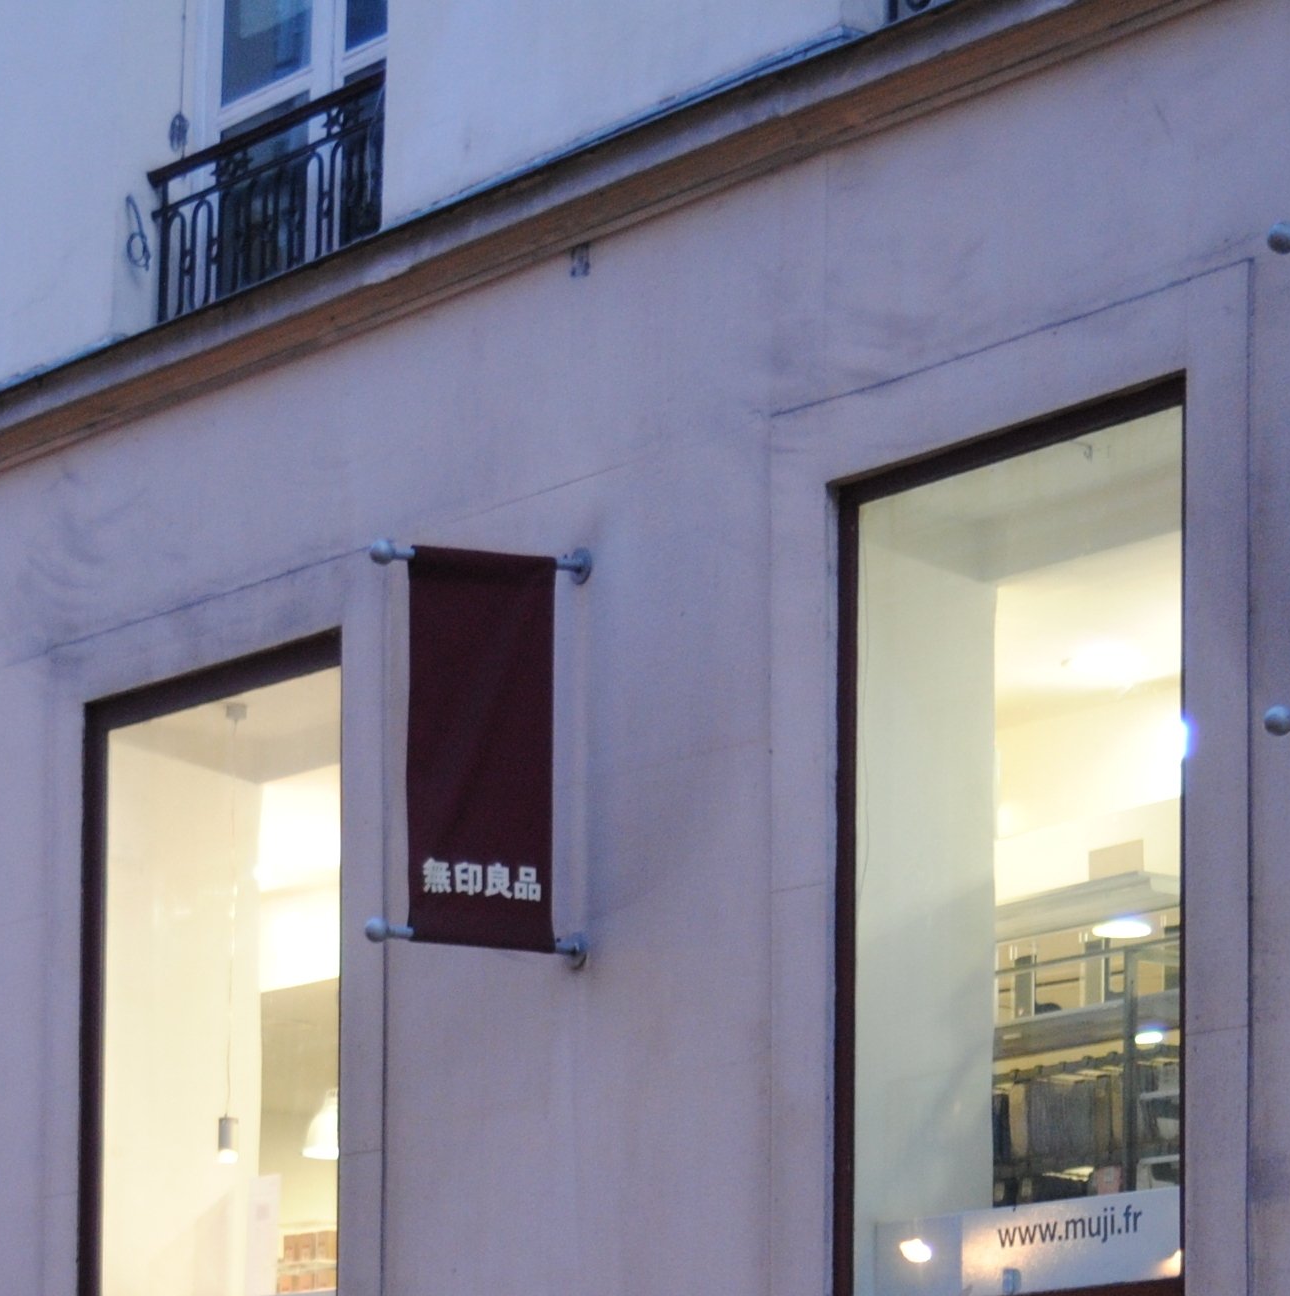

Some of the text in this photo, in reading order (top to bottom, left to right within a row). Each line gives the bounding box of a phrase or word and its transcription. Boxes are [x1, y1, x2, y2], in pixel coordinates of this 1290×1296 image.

[422, 857, 542, 902] 無印良品
[997, 1204, 1142, 1248] www.muji.fr
